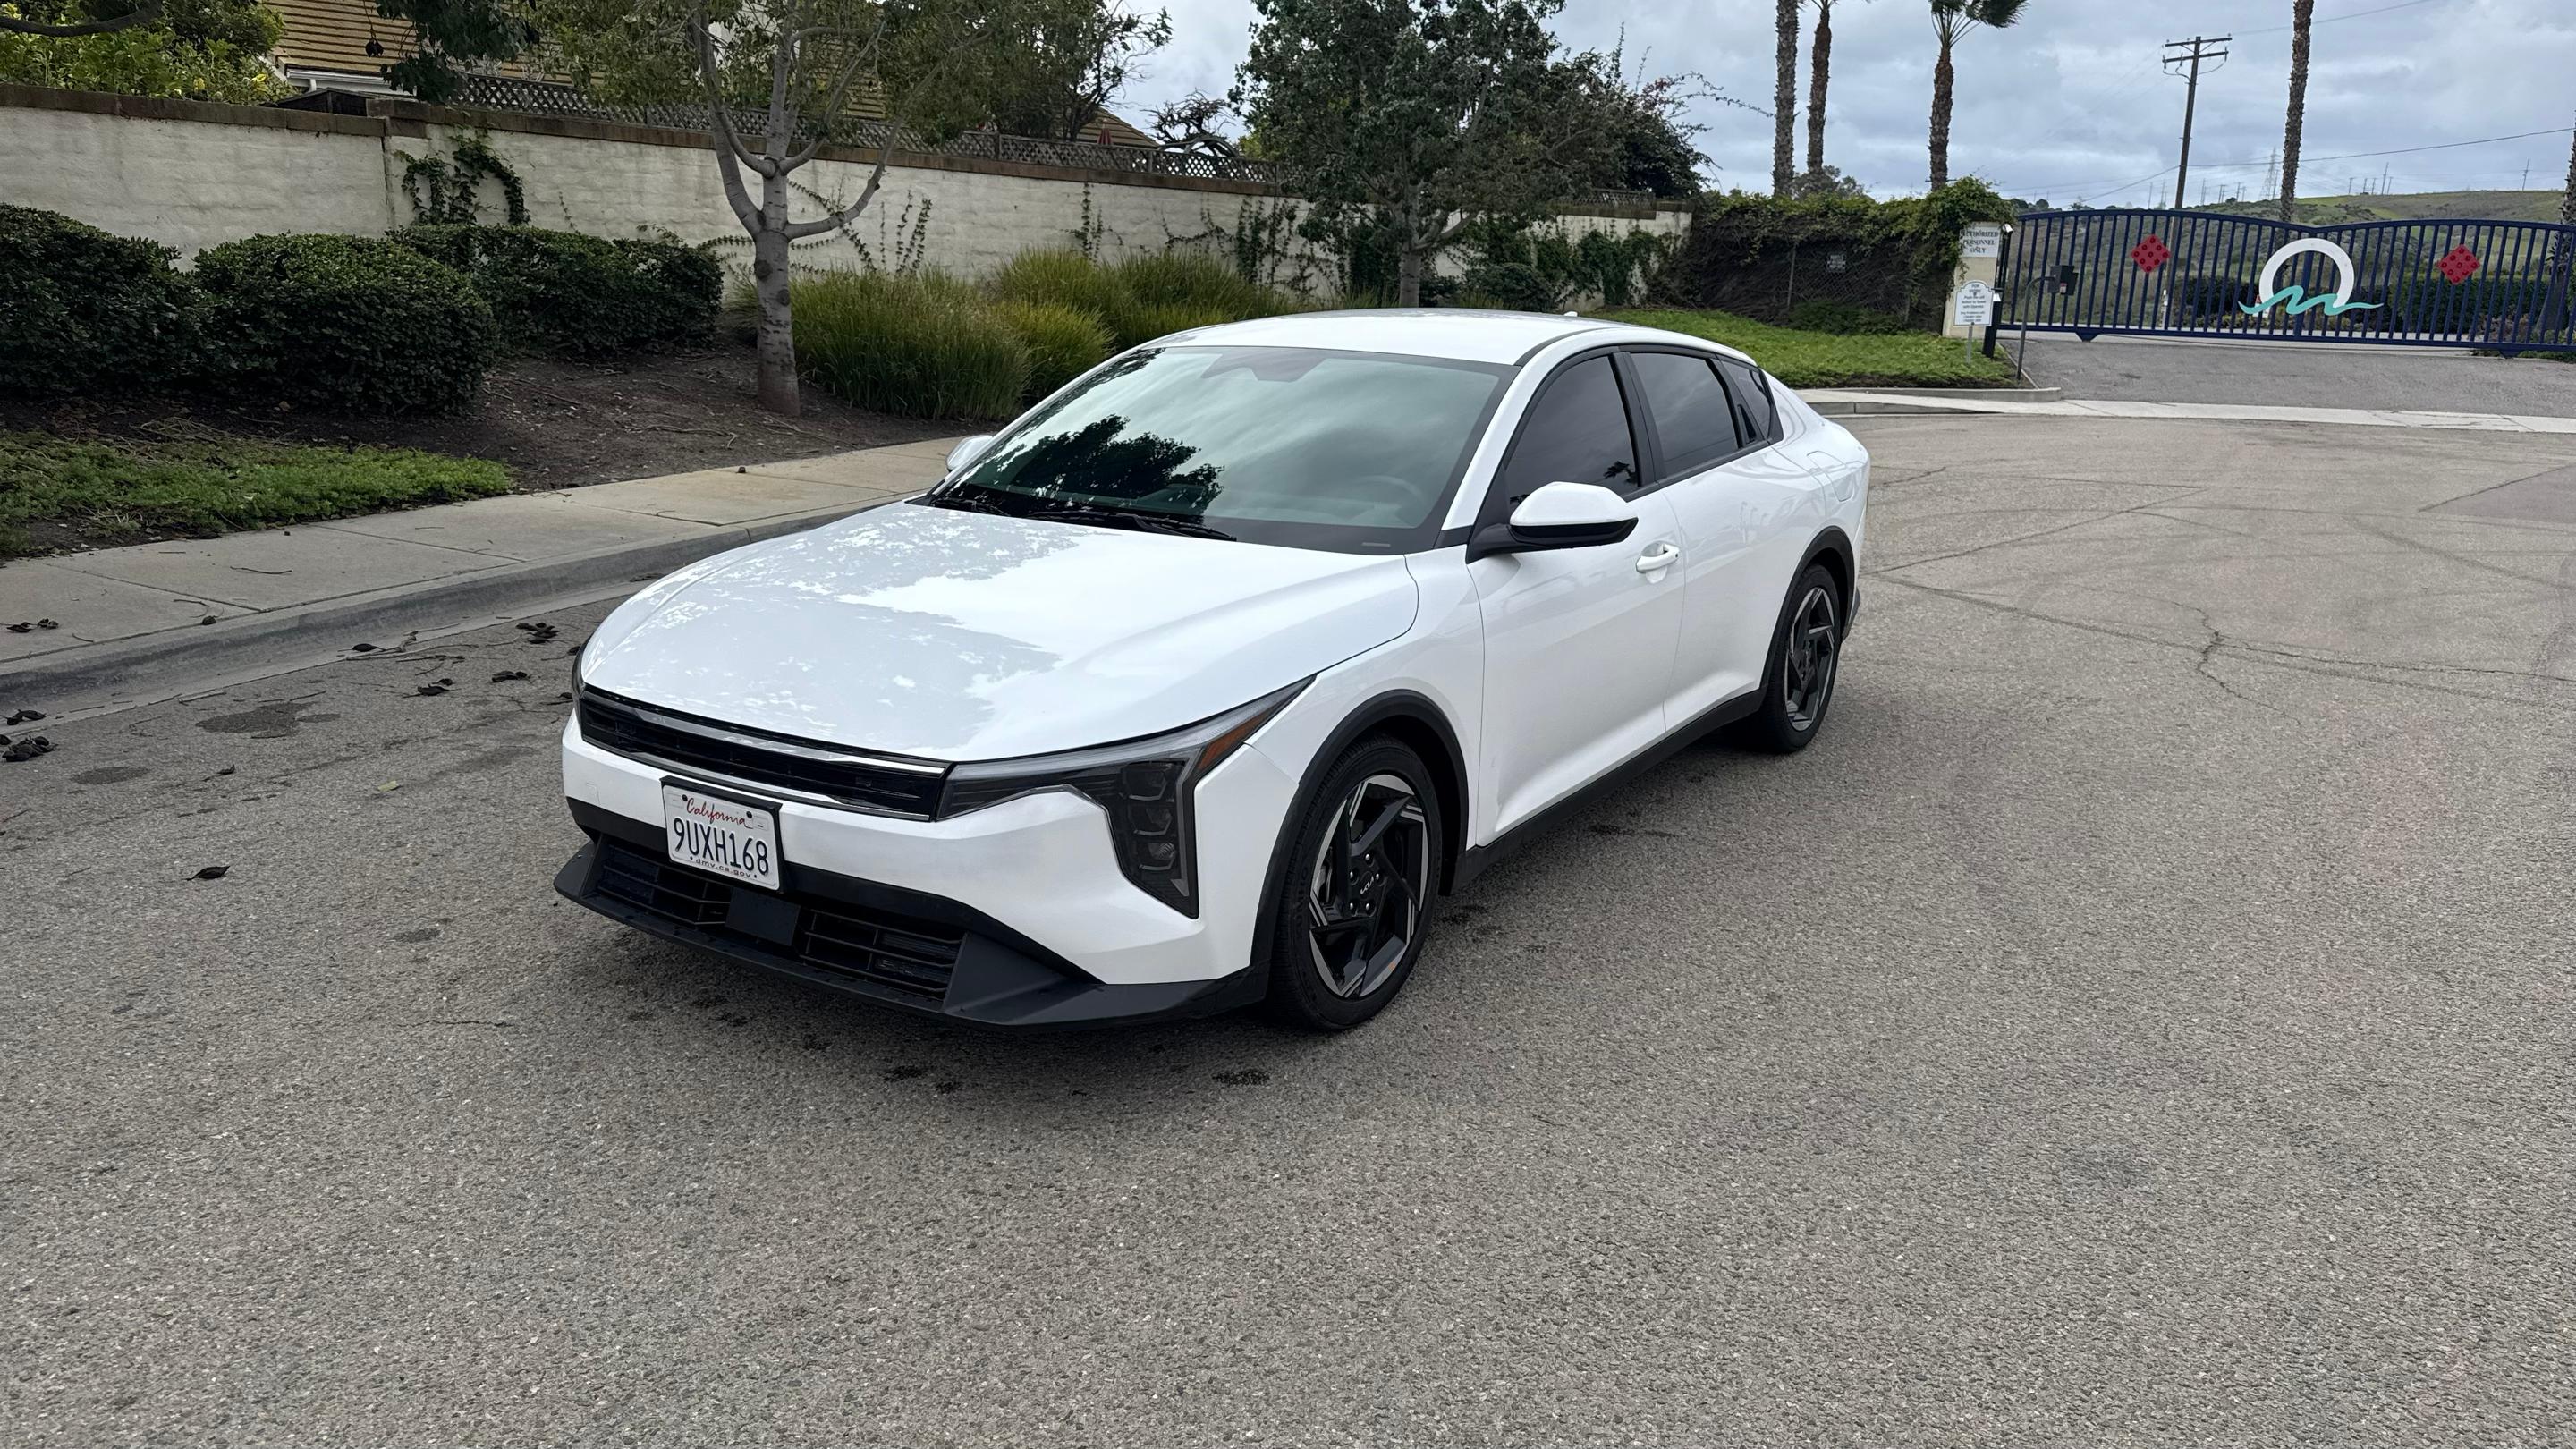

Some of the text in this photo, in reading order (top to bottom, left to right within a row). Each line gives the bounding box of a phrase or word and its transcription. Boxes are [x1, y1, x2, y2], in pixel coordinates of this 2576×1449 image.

[687, 797, 753, 829] California
[674, 818, 769, 875] 9UXH168
[695, 859, 751, 877] dmv.ca.gov
